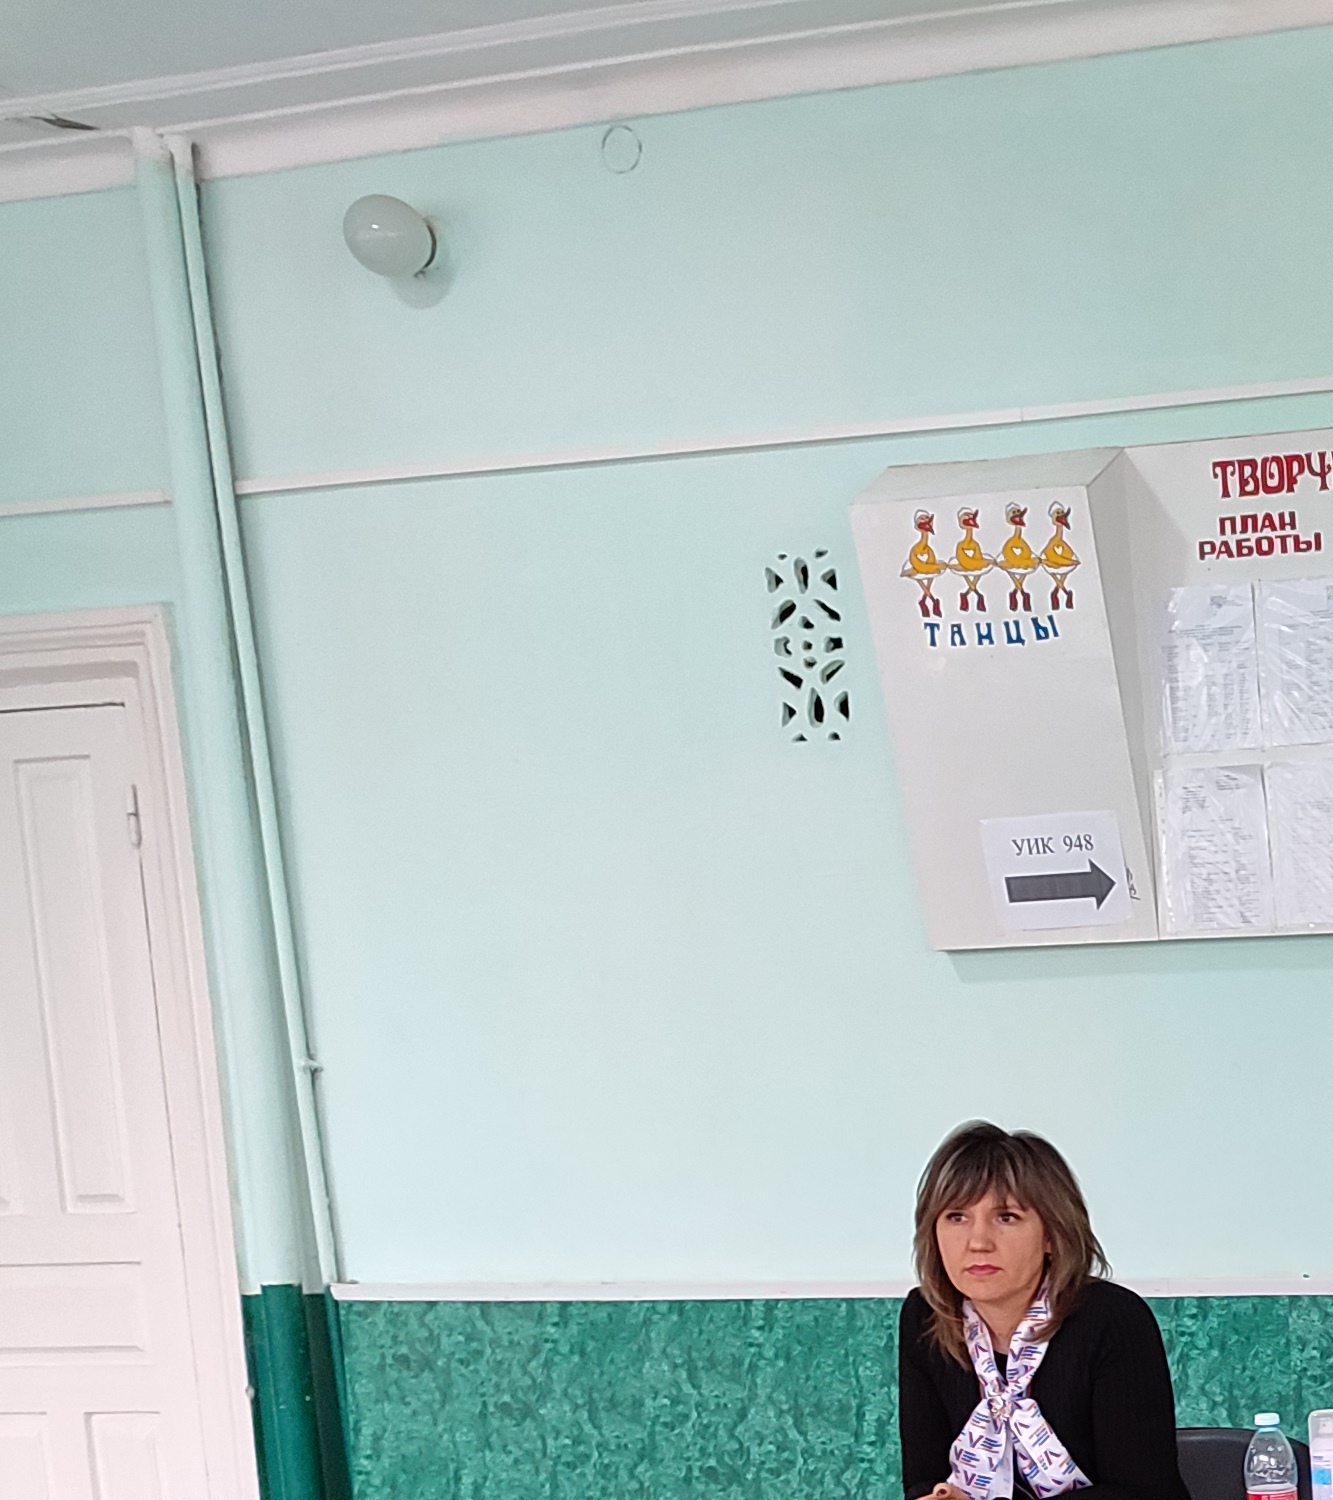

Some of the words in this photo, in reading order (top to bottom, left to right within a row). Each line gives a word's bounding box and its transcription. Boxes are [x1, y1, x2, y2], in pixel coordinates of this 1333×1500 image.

[1218, 511, 1297, 536] ПЛАН
[1198, 532, 1322, 561] РАБОТЫ
[923, 614, 1060, 648] ТАНЦЫ
[1011, 835, 1055, 857] УИК
[1062, 833, 1095, 854] 948
